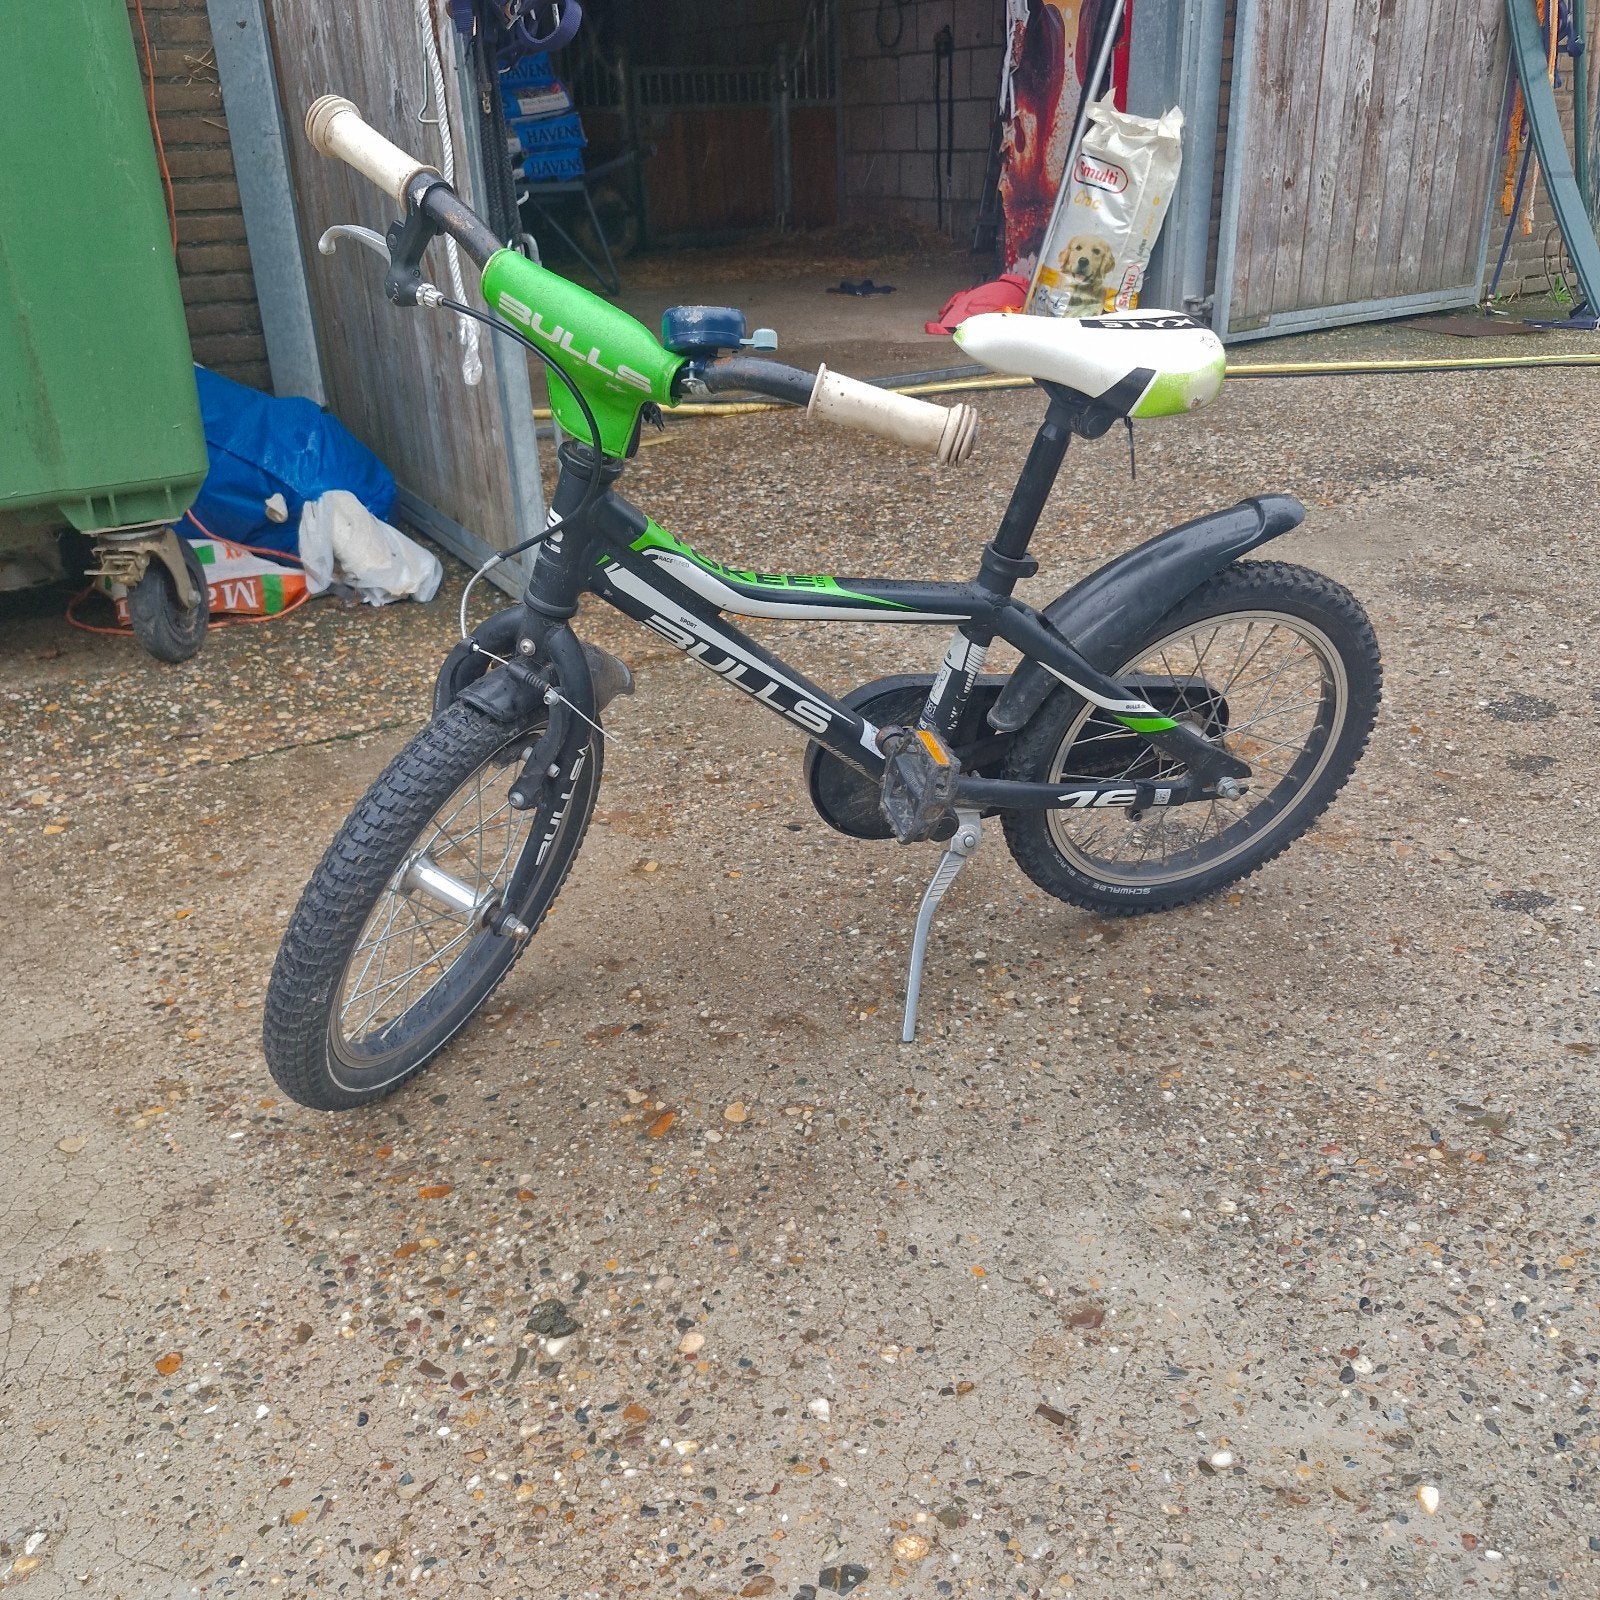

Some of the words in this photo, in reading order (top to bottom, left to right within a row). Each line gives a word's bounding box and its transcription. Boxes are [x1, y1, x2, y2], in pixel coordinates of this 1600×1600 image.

[526, 124, 581, 144] HAVENS
[530, 158, 583, 174] HAVENS
[1099, 318, 1195, 328] STYX
[498, 291, 652, 394] BULLS
[679, 616, 698, 629] SPORT
[640, 614, 832, 734] BULLS
[1053, 853, 1077, 878] BLACK
[1092, 882, 1151, 895] SCHWALBE
